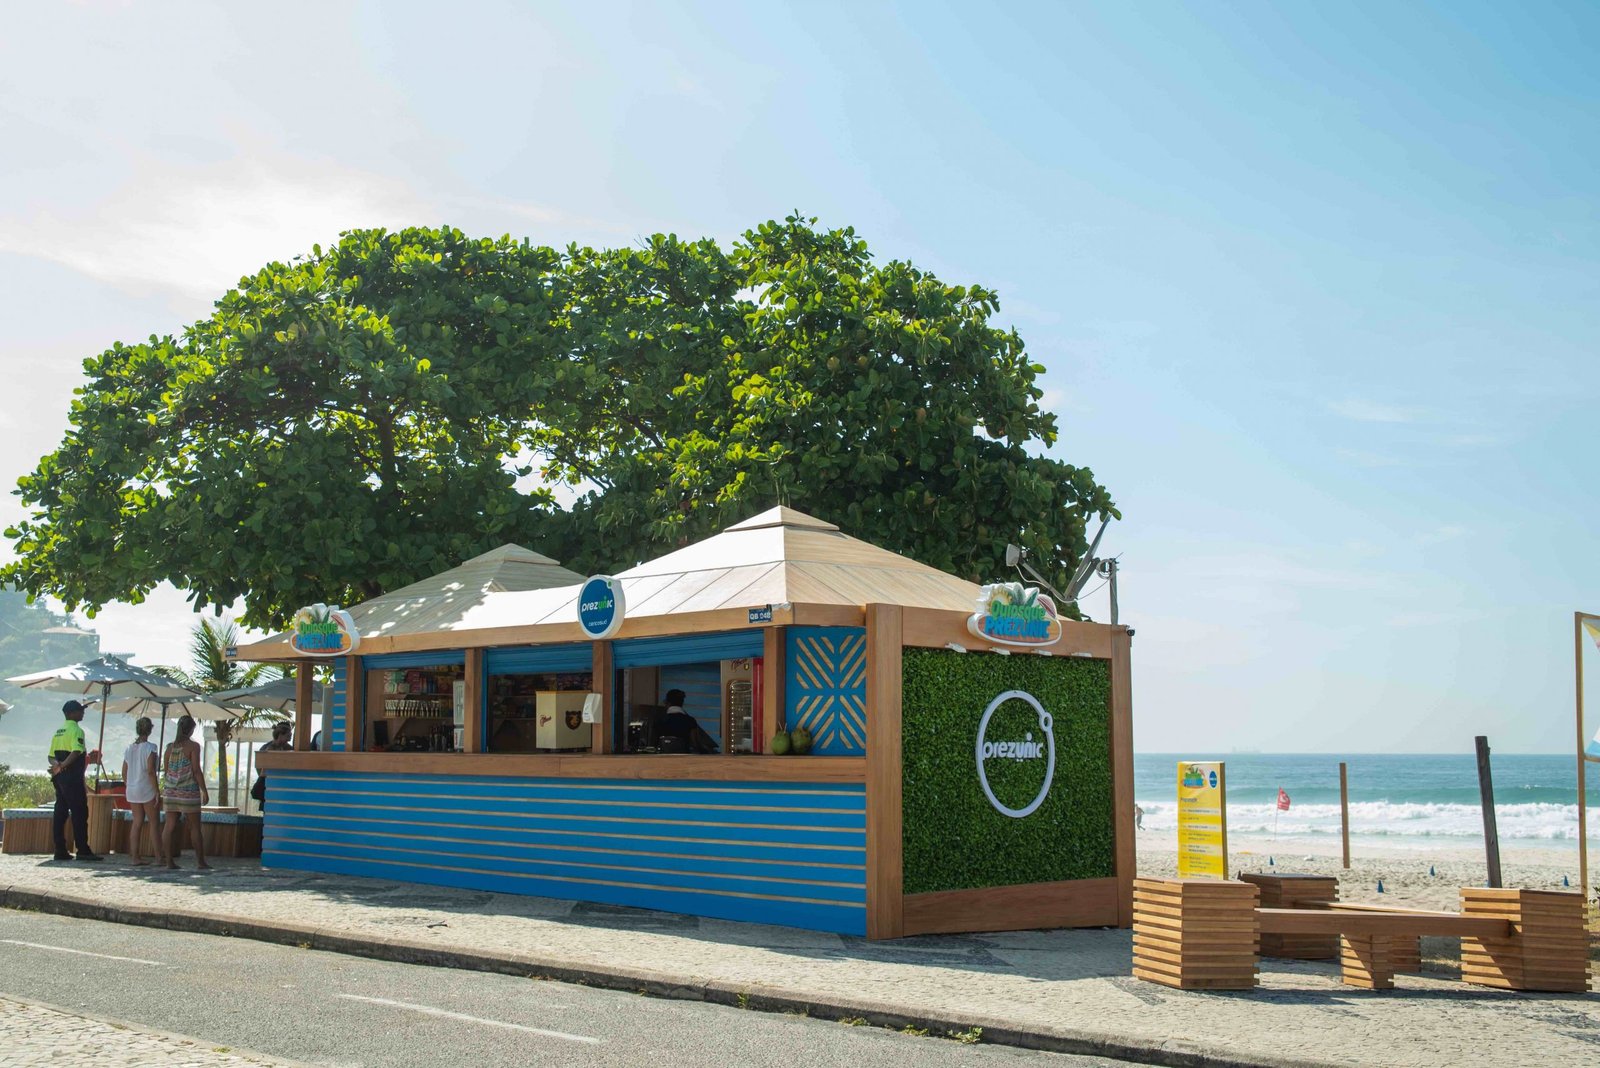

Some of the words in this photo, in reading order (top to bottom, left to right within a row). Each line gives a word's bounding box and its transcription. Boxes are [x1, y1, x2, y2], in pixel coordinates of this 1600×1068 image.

[991, 600, 1046, 622] Quiosque
[984, 615, 1050, 639] PREZUNIC
[982, 732, 1043, 762] prezunic
